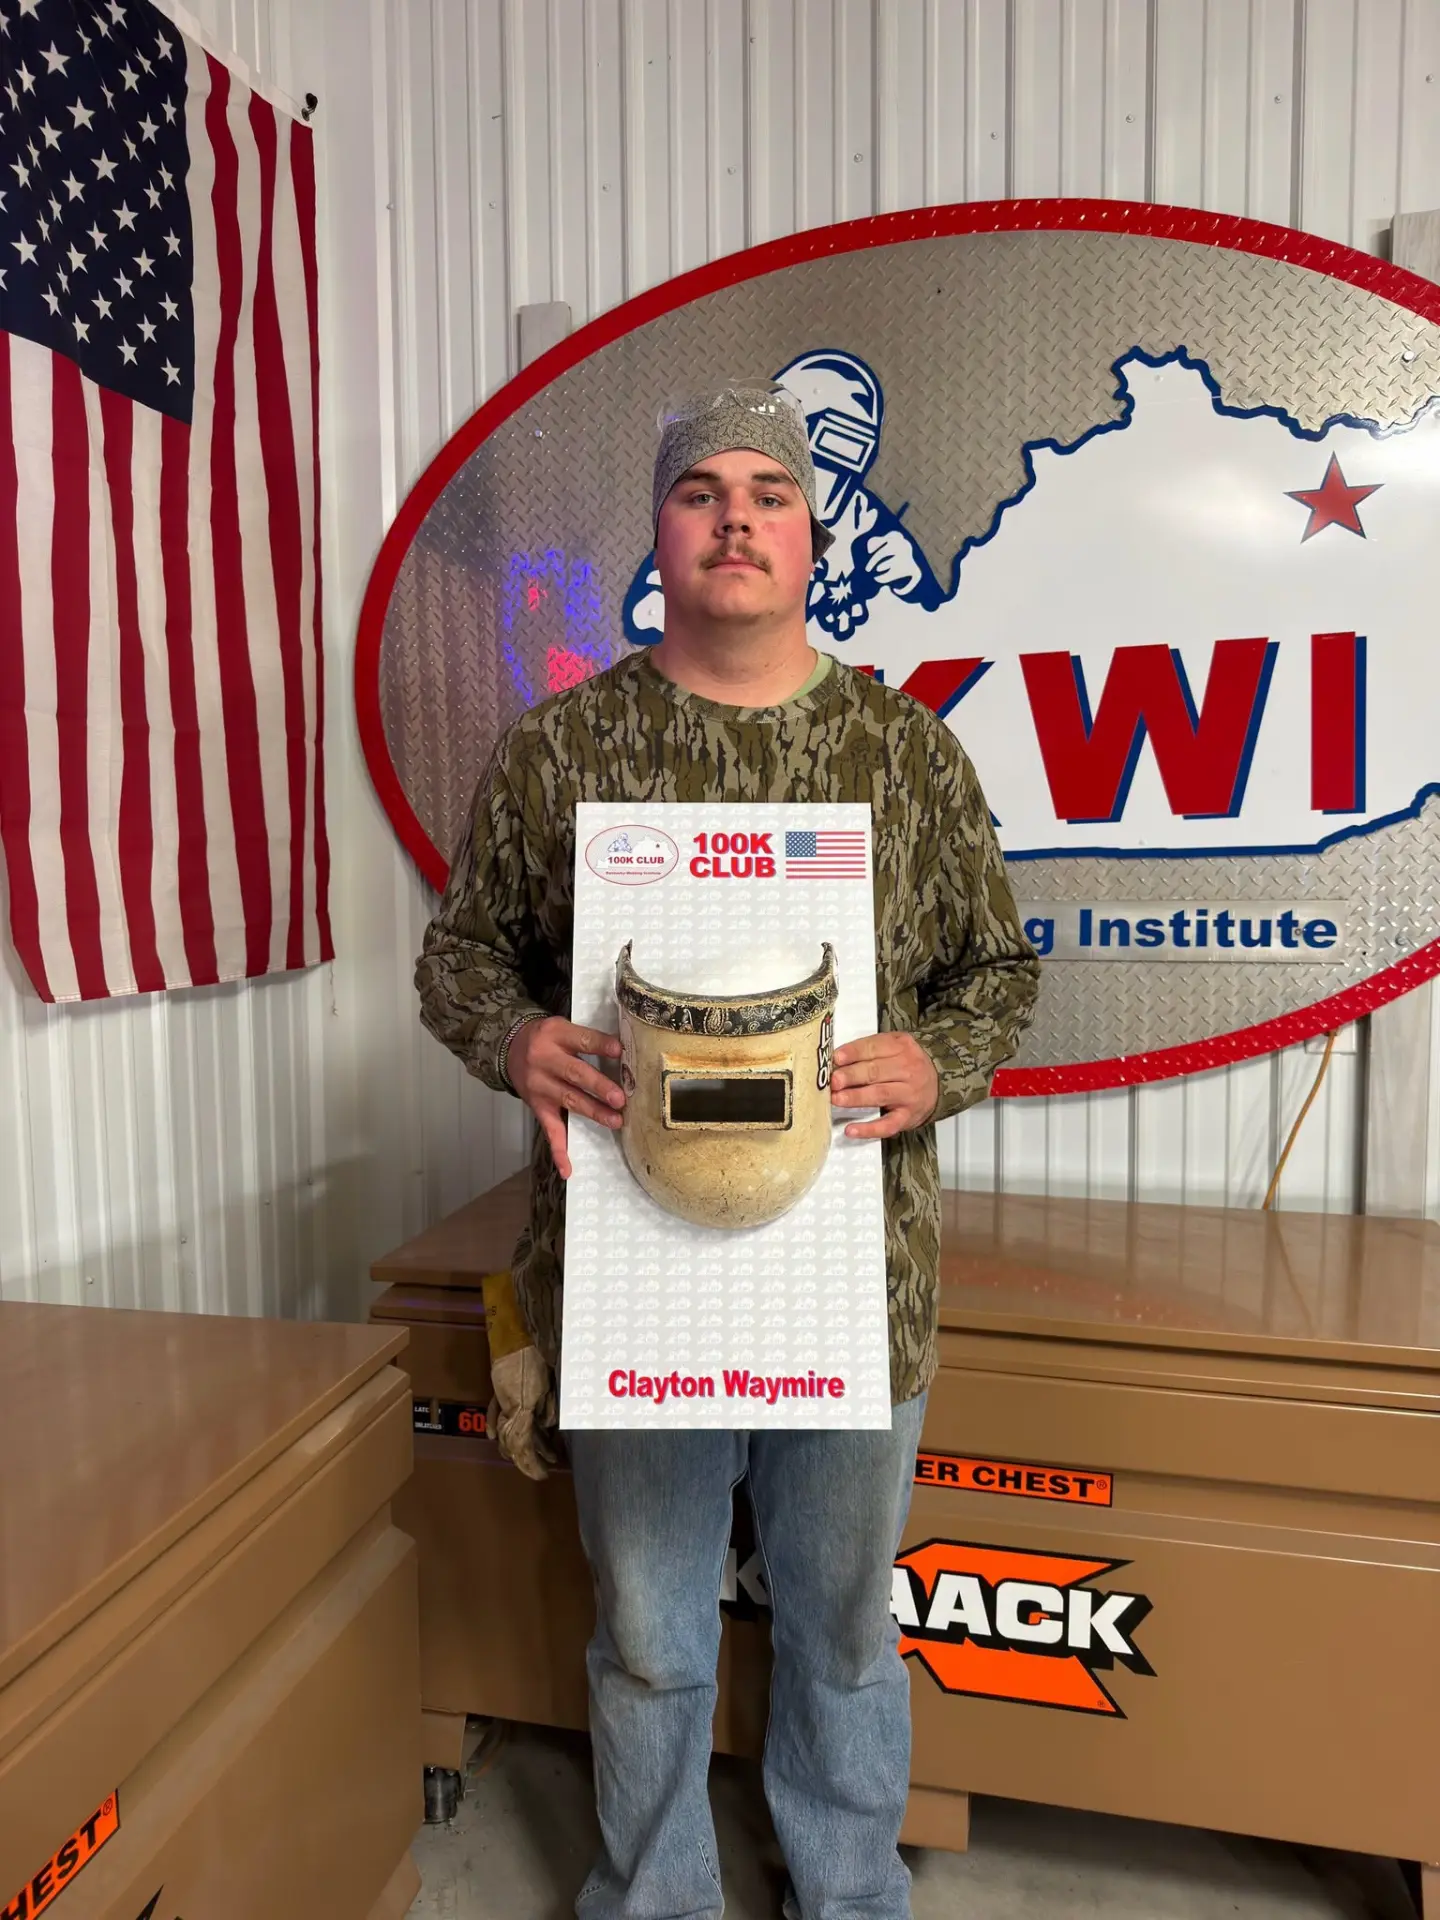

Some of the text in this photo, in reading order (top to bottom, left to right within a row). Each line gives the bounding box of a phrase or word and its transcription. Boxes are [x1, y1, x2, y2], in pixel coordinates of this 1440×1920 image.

[856, 631, 1366, 826] WI
[692, 831, 774, 855] 100K
[608, 856, 665, 864] 100K CLUB
[689, 856, 776, 879] CLUB
[1080, 908, 1337, 949] Institute
[608, 1369, 845, 1405] Clayton Waymire
[459, 1411, 485, 1433] 60
